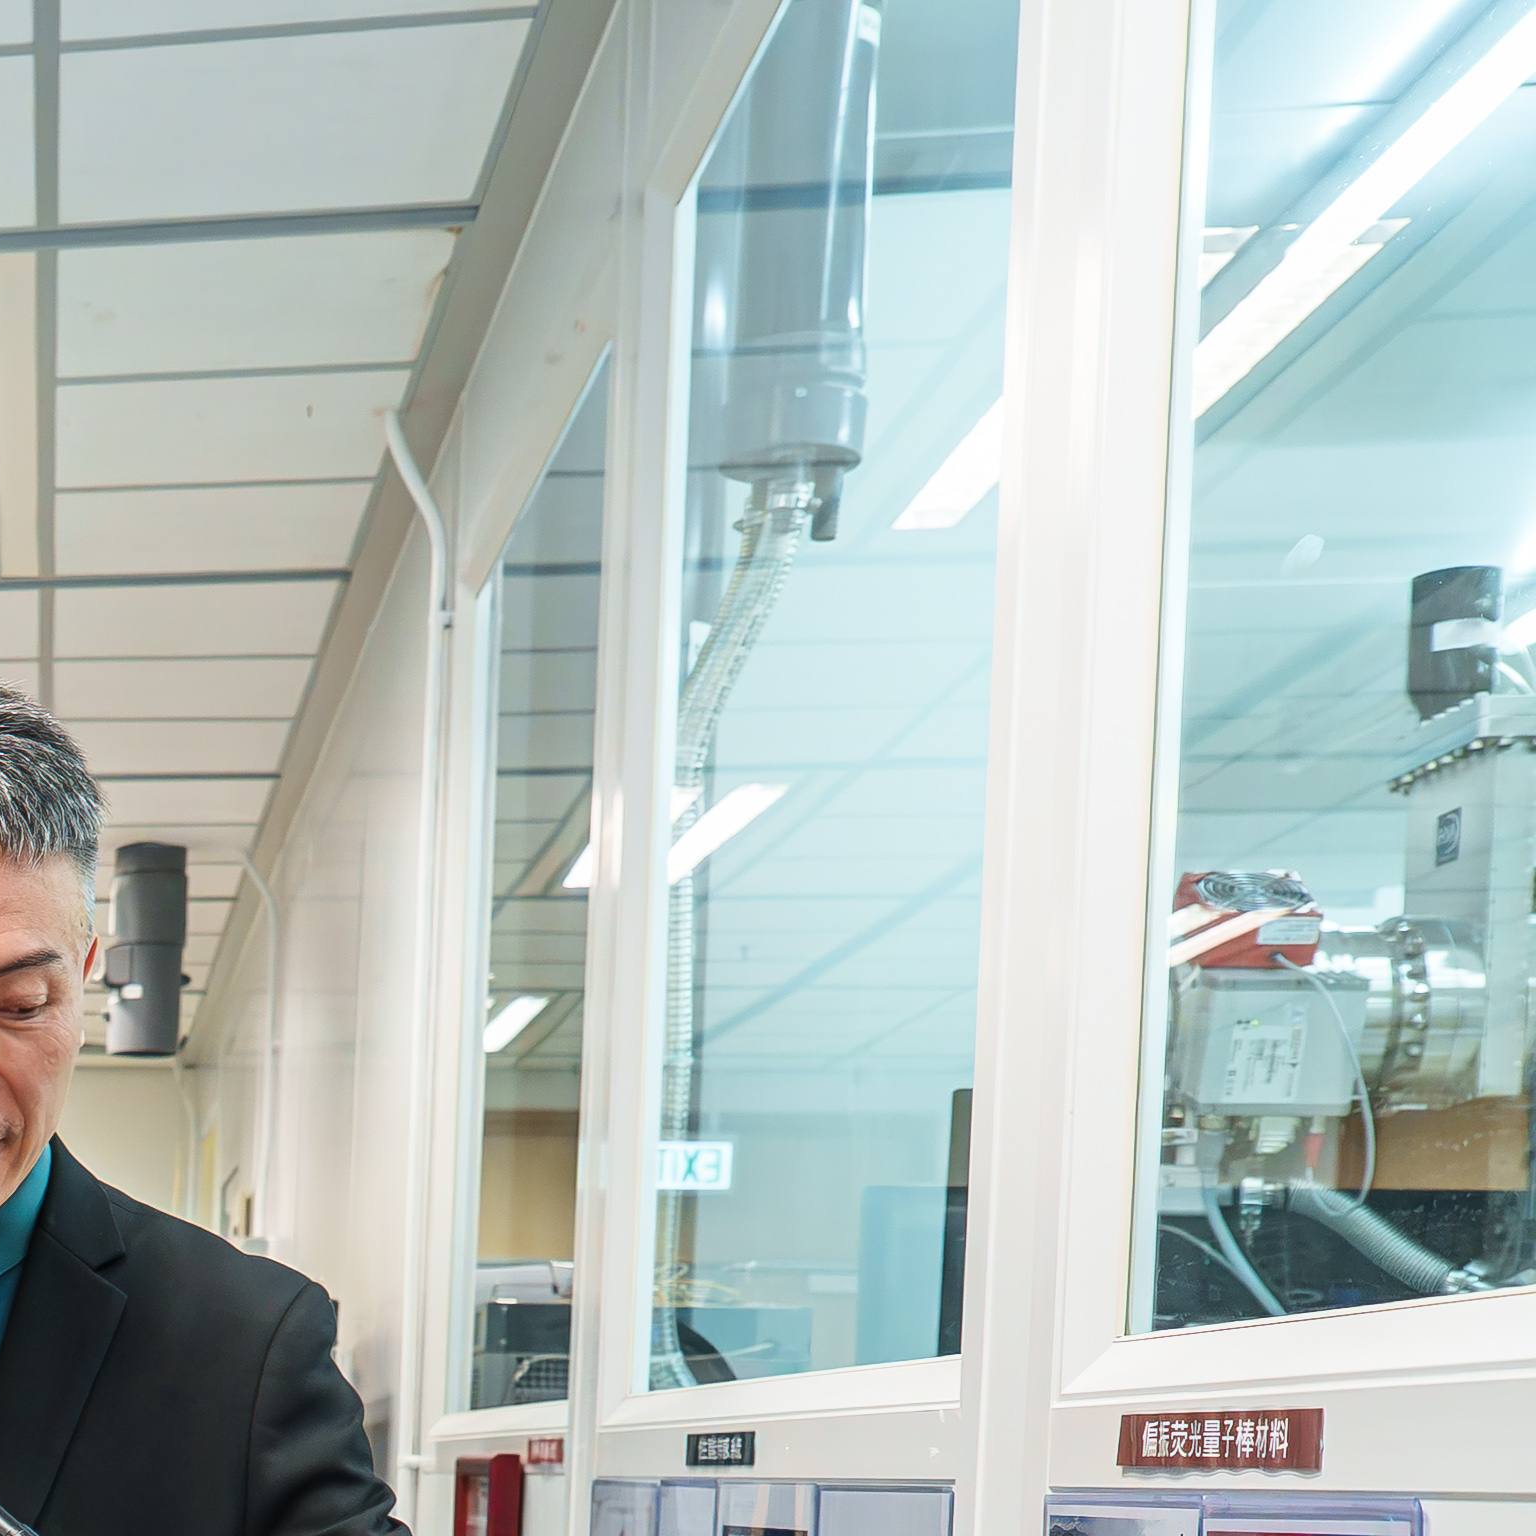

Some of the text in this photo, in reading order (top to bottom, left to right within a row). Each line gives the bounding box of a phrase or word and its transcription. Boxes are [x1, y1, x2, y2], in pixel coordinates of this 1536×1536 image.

[1142, 1418, 1289, 1459] 偏振荧光量子棒材料
